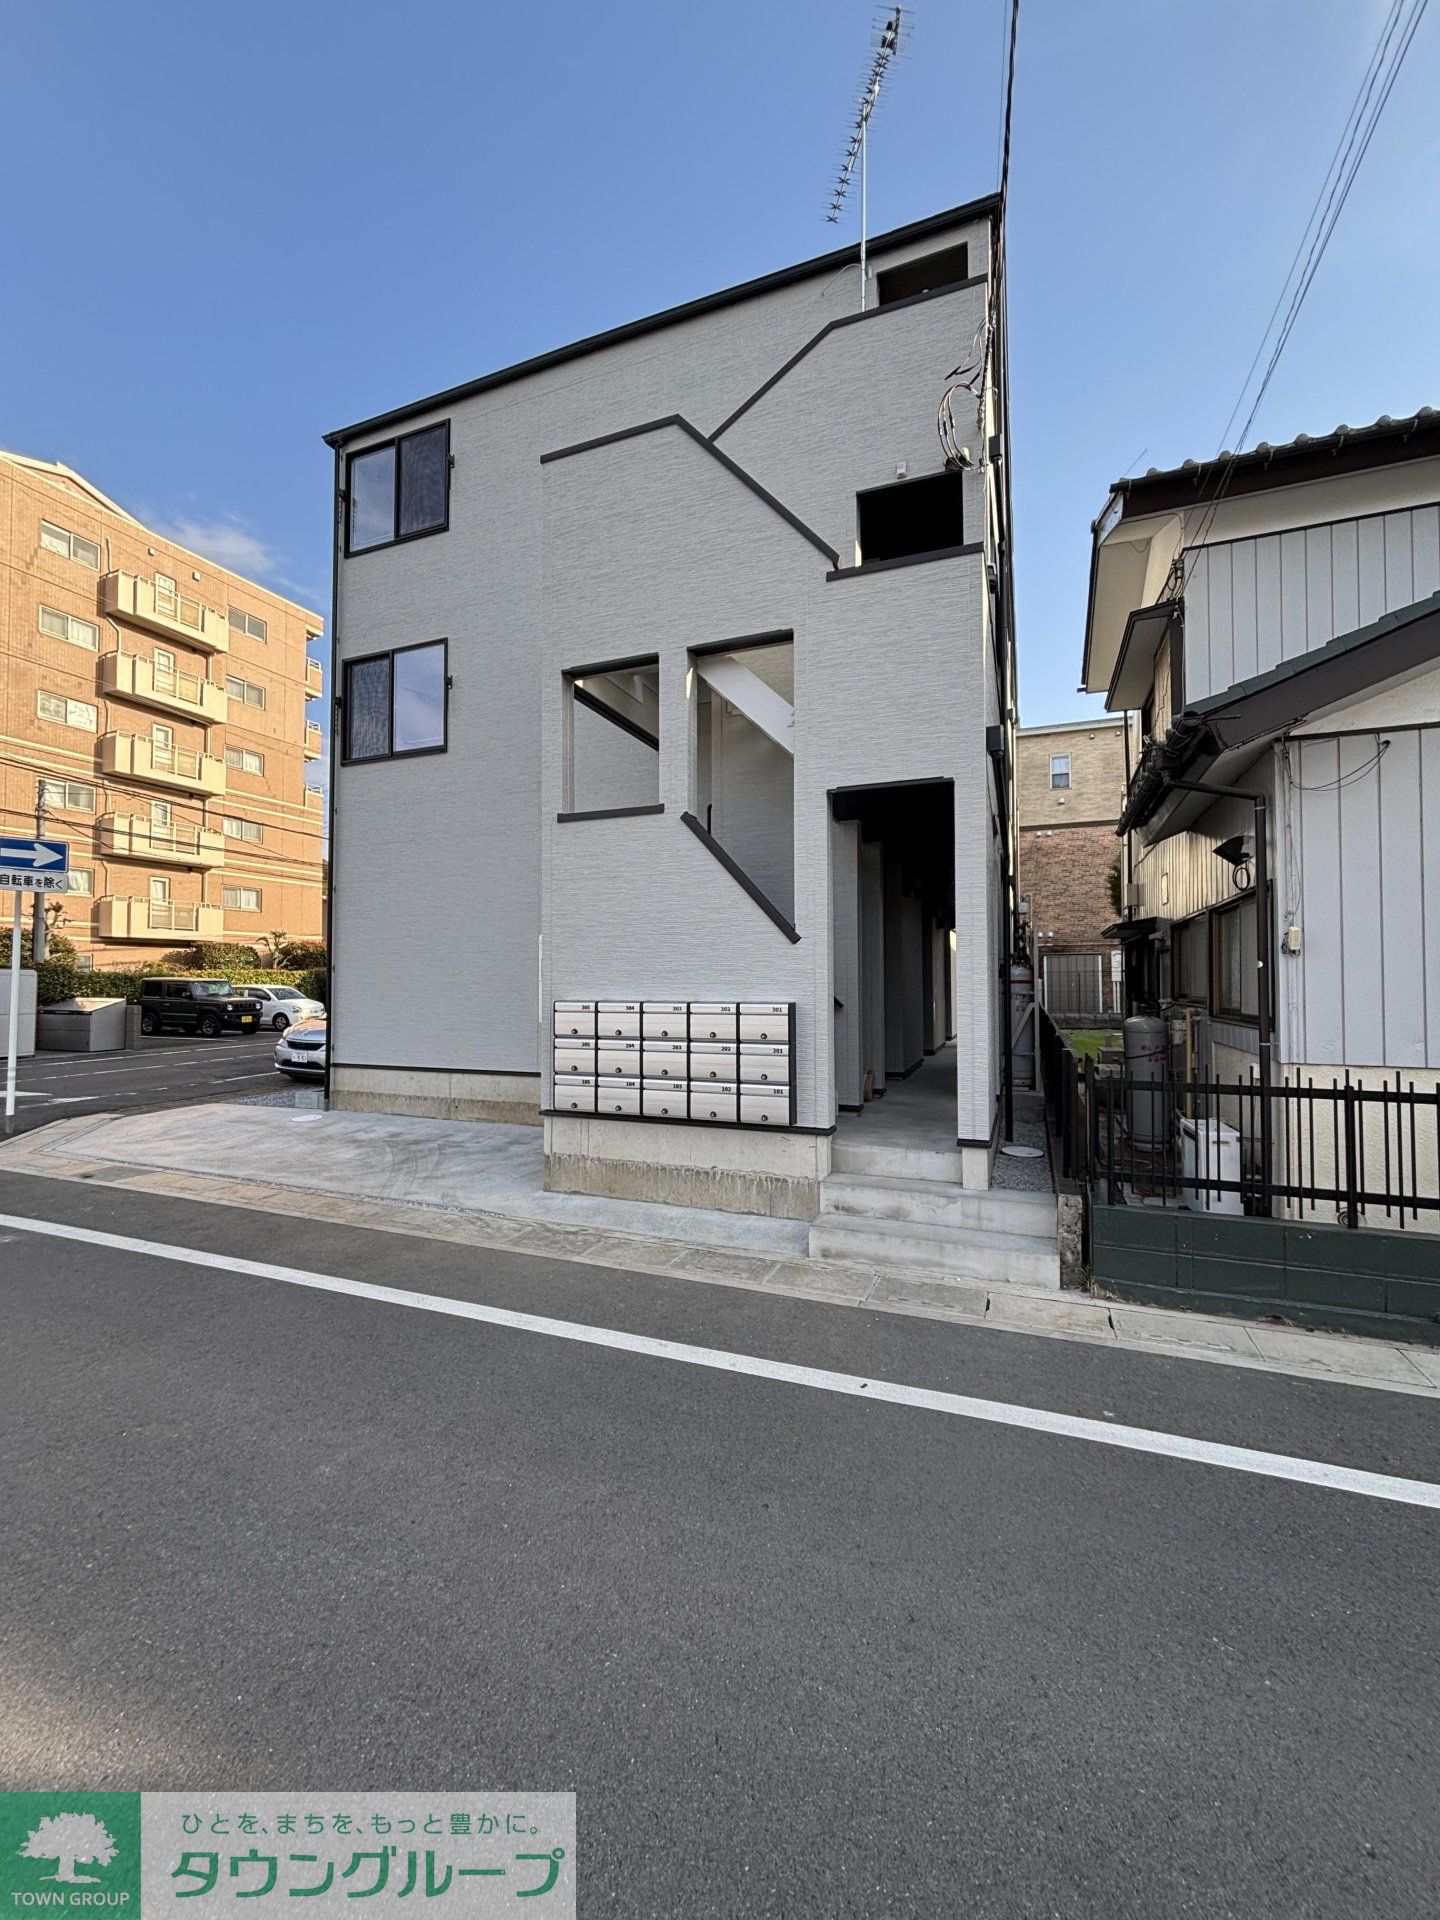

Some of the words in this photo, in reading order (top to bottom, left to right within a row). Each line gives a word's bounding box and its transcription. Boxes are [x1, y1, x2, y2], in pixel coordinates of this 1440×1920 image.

[0, 873, 63, 889] 自転車を除く
